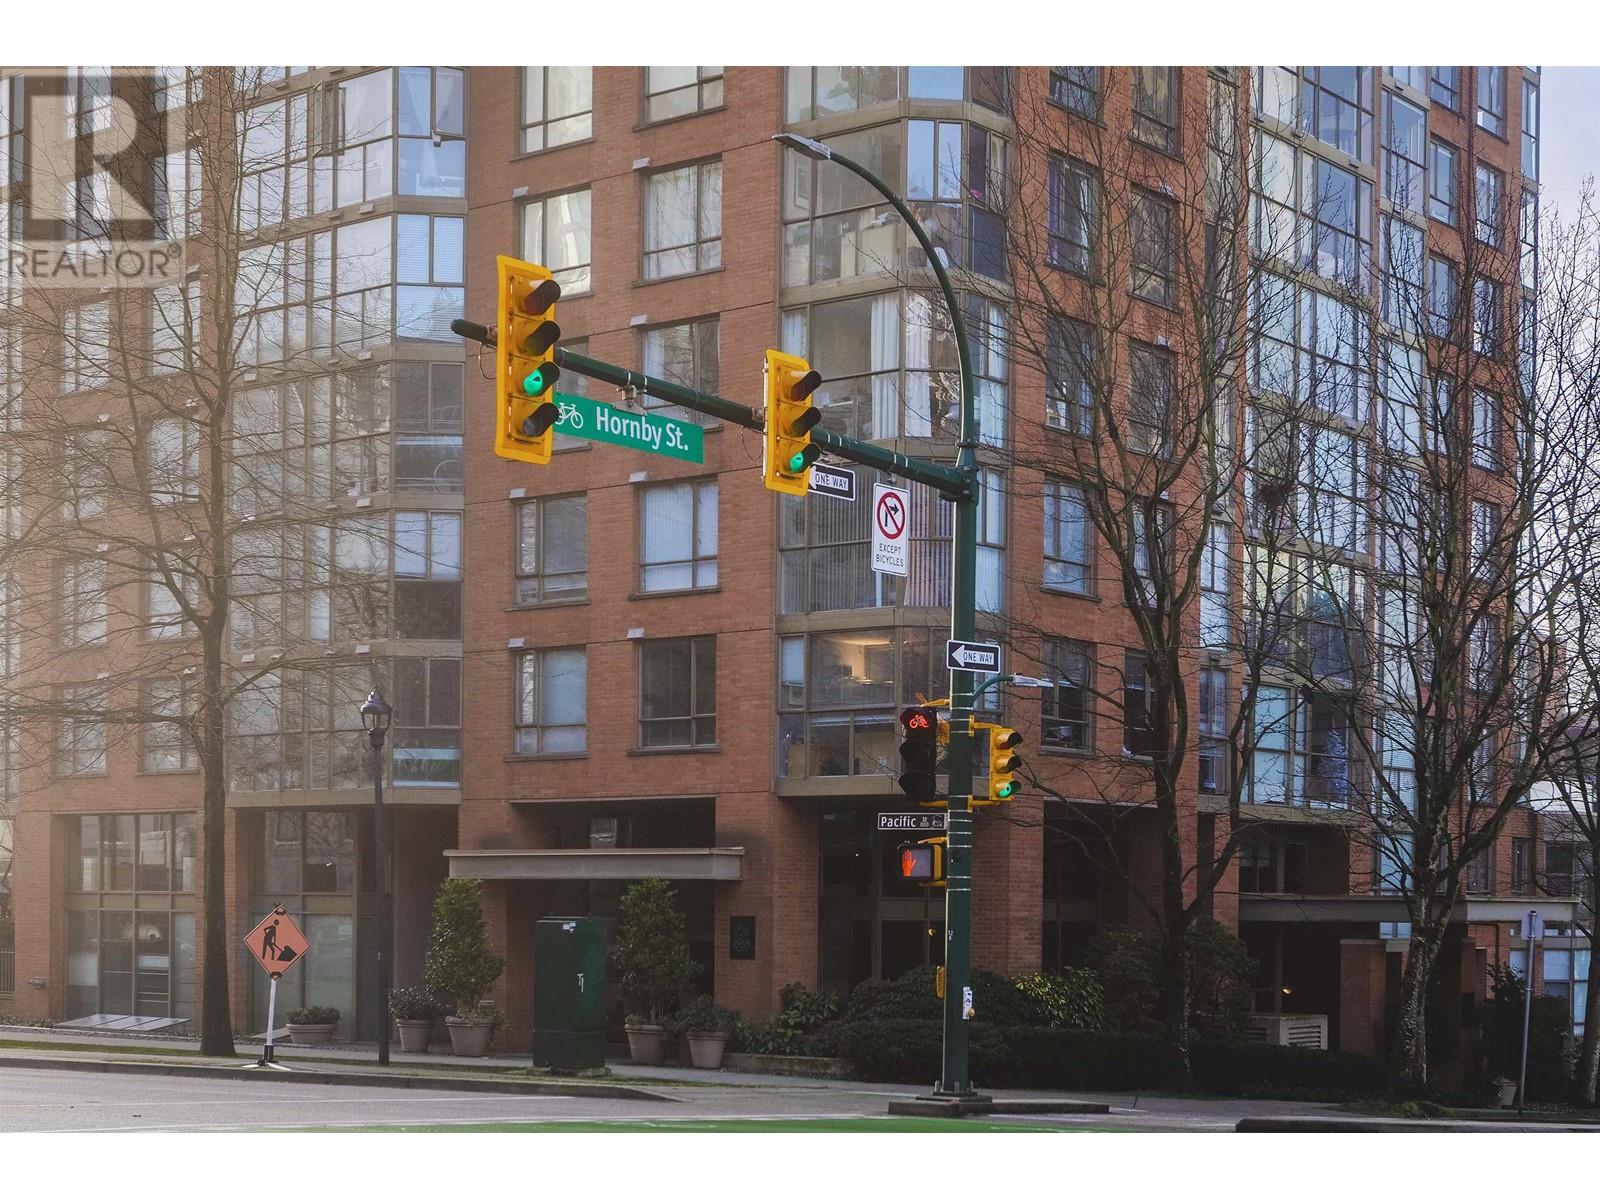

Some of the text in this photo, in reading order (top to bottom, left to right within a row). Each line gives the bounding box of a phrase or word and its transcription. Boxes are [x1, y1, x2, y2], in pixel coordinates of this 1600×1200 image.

[595, 406, 689, 451] Hornby St.
[814, 472, 848, 489] ONE WAY
[879, 542, 901, 554] EXCEPT
[875, 553, 904, 567] BICYCLES
[963, 651, 993, 664] ONE WAY
[880, 815, 917, 828] Pacific
